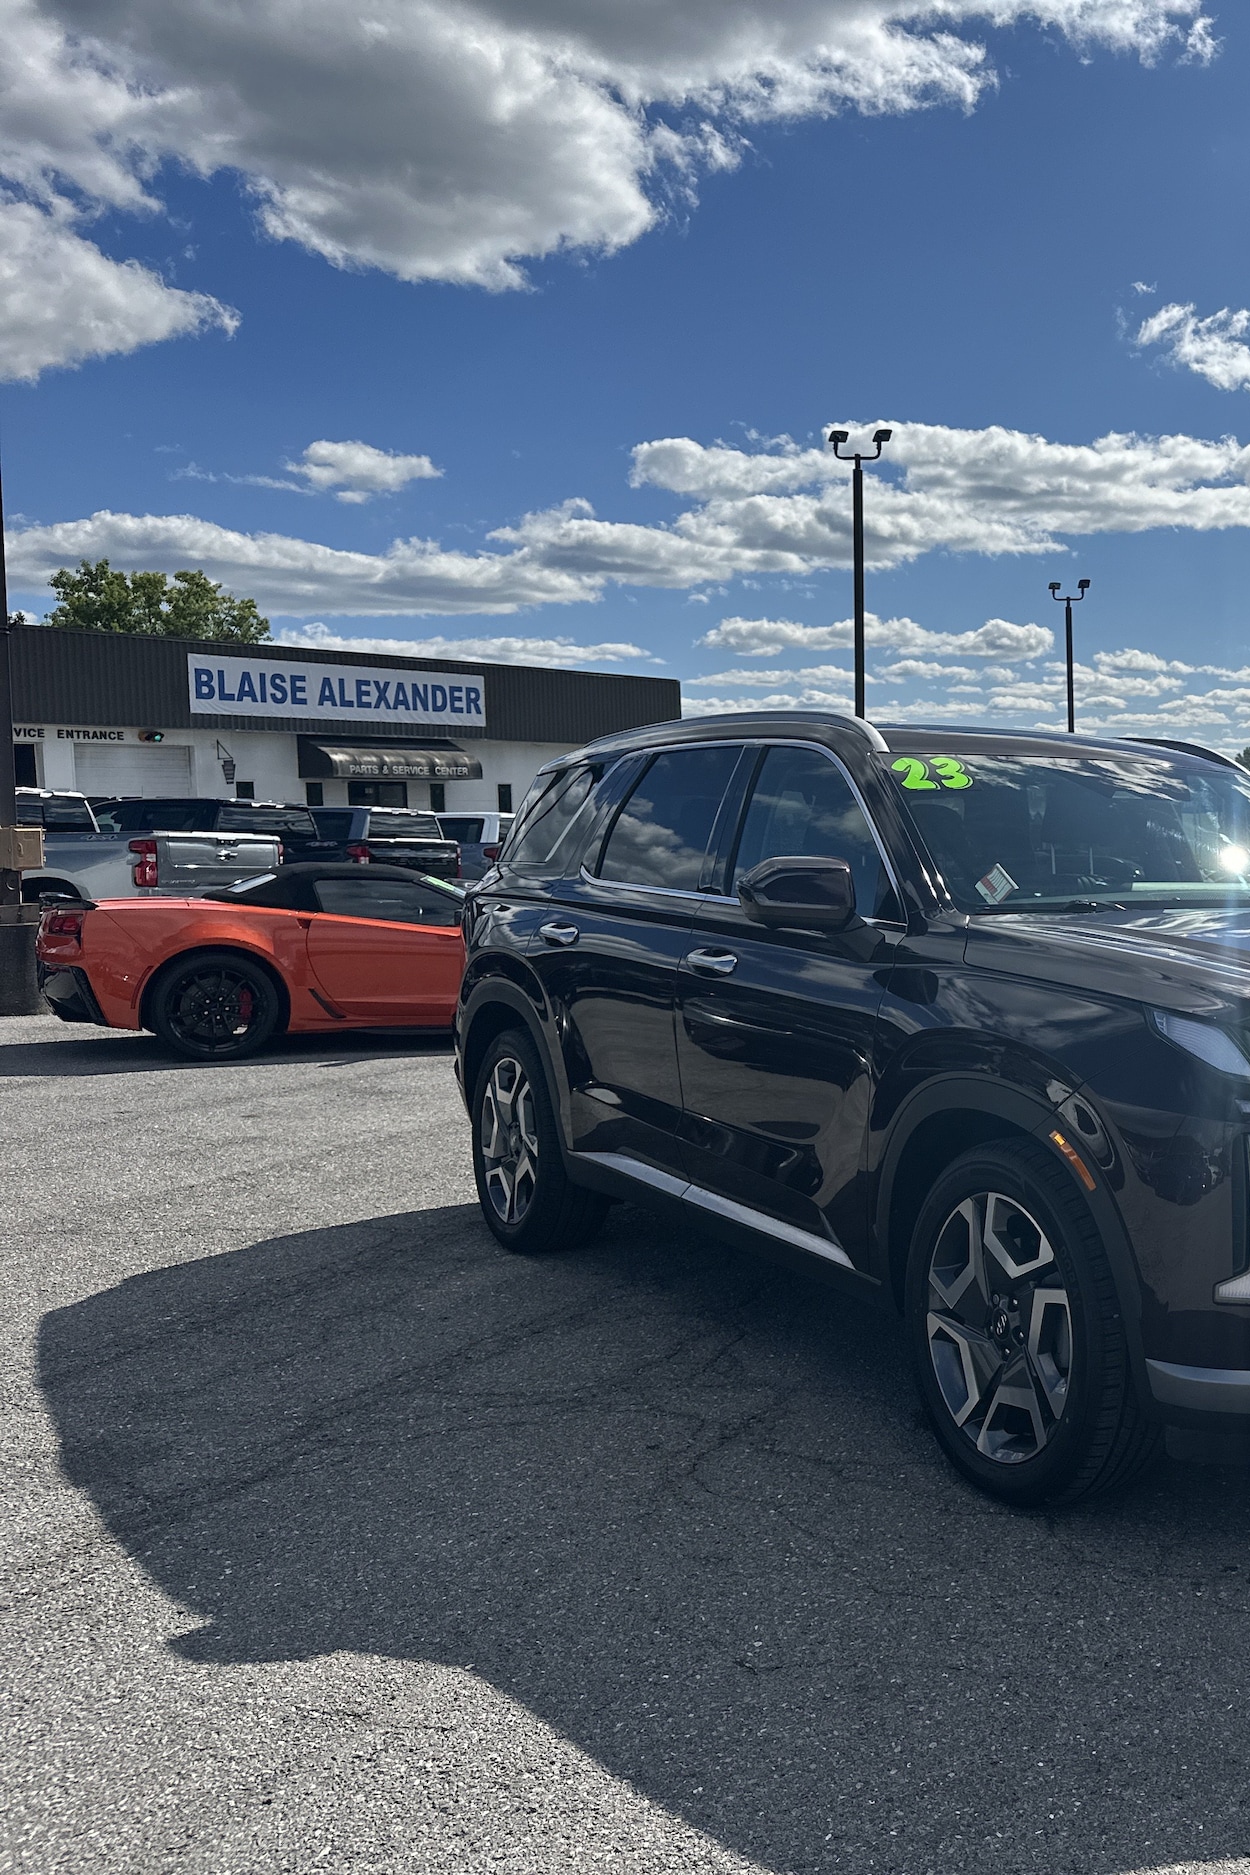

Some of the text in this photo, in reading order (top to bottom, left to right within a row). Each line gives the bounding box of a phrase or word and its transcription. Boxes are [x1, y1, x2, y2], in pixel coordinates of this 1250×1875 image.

[193, 667, 483, 715] BLAISE ALEXANDER
[56, 729, 125, 741] ENTRANCE
[349, 764, 469, 776] PARTS & SERVICE CENTER
[890, 756, 974, 791] 23
